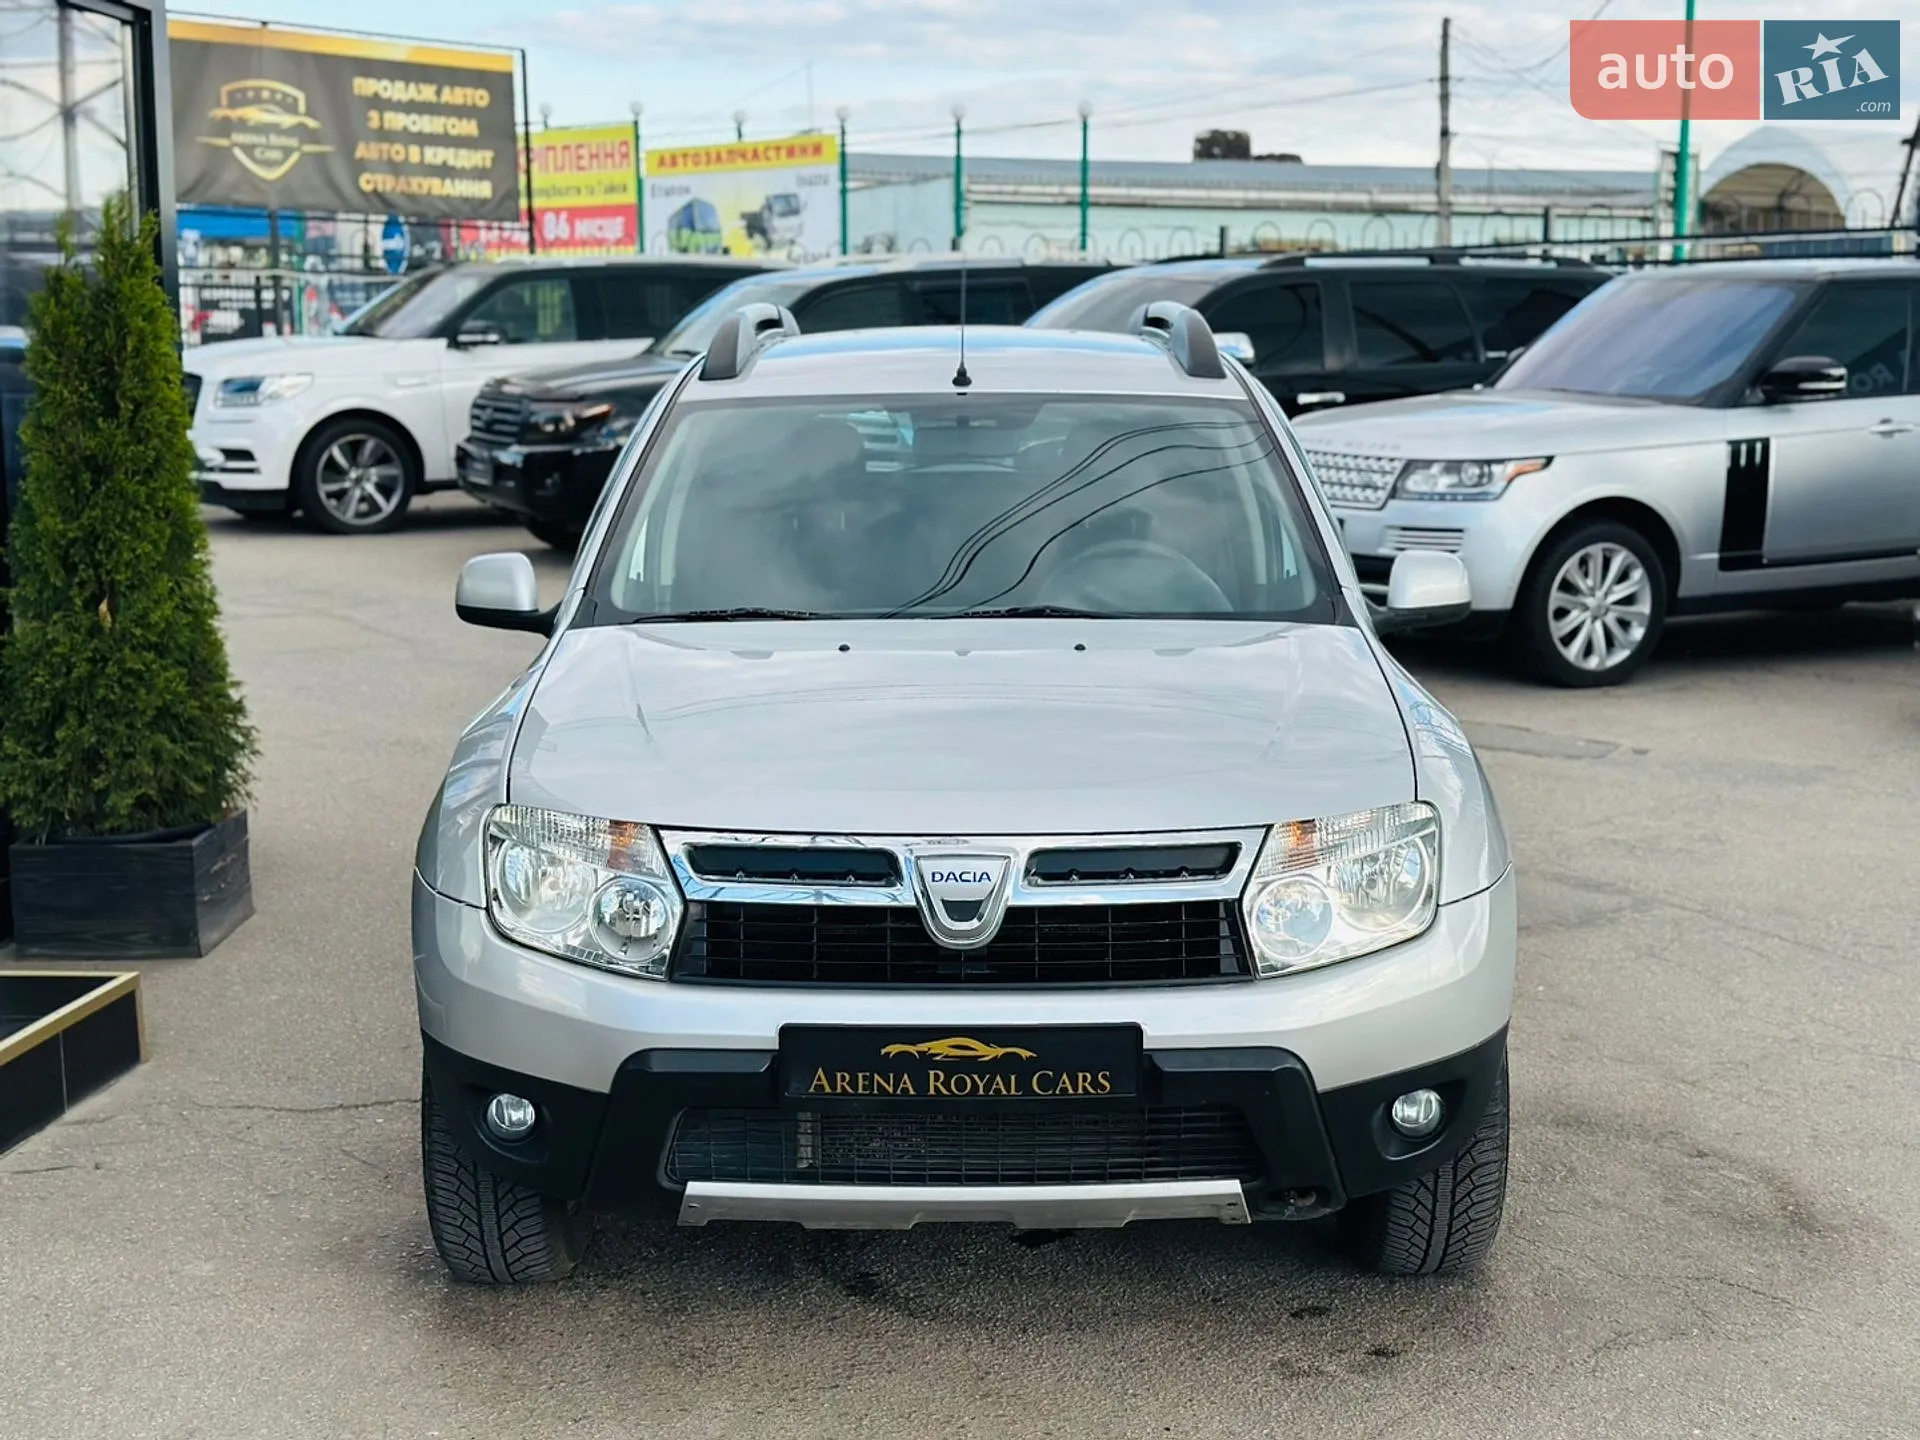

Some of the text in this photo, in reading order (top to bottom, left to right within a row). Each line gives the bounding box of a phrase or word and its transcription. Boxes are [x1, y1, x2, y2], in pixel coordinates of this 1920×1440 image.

[353, 76, 490, 108] ПРОДАЖ АВТО
[354, 141, 406, 163] АВТО
[423, 145, 495, 170] КРЕДИТ
[657, 142, 823, 168] АВТОЗАПЧАСТИНИ
[358, 171, 492, 199] СТРАХУВАННЯ
[931, 871, 992, 883] DACIA
[808, 1067, 1111, 1096] ARENA ROYAL CARS
